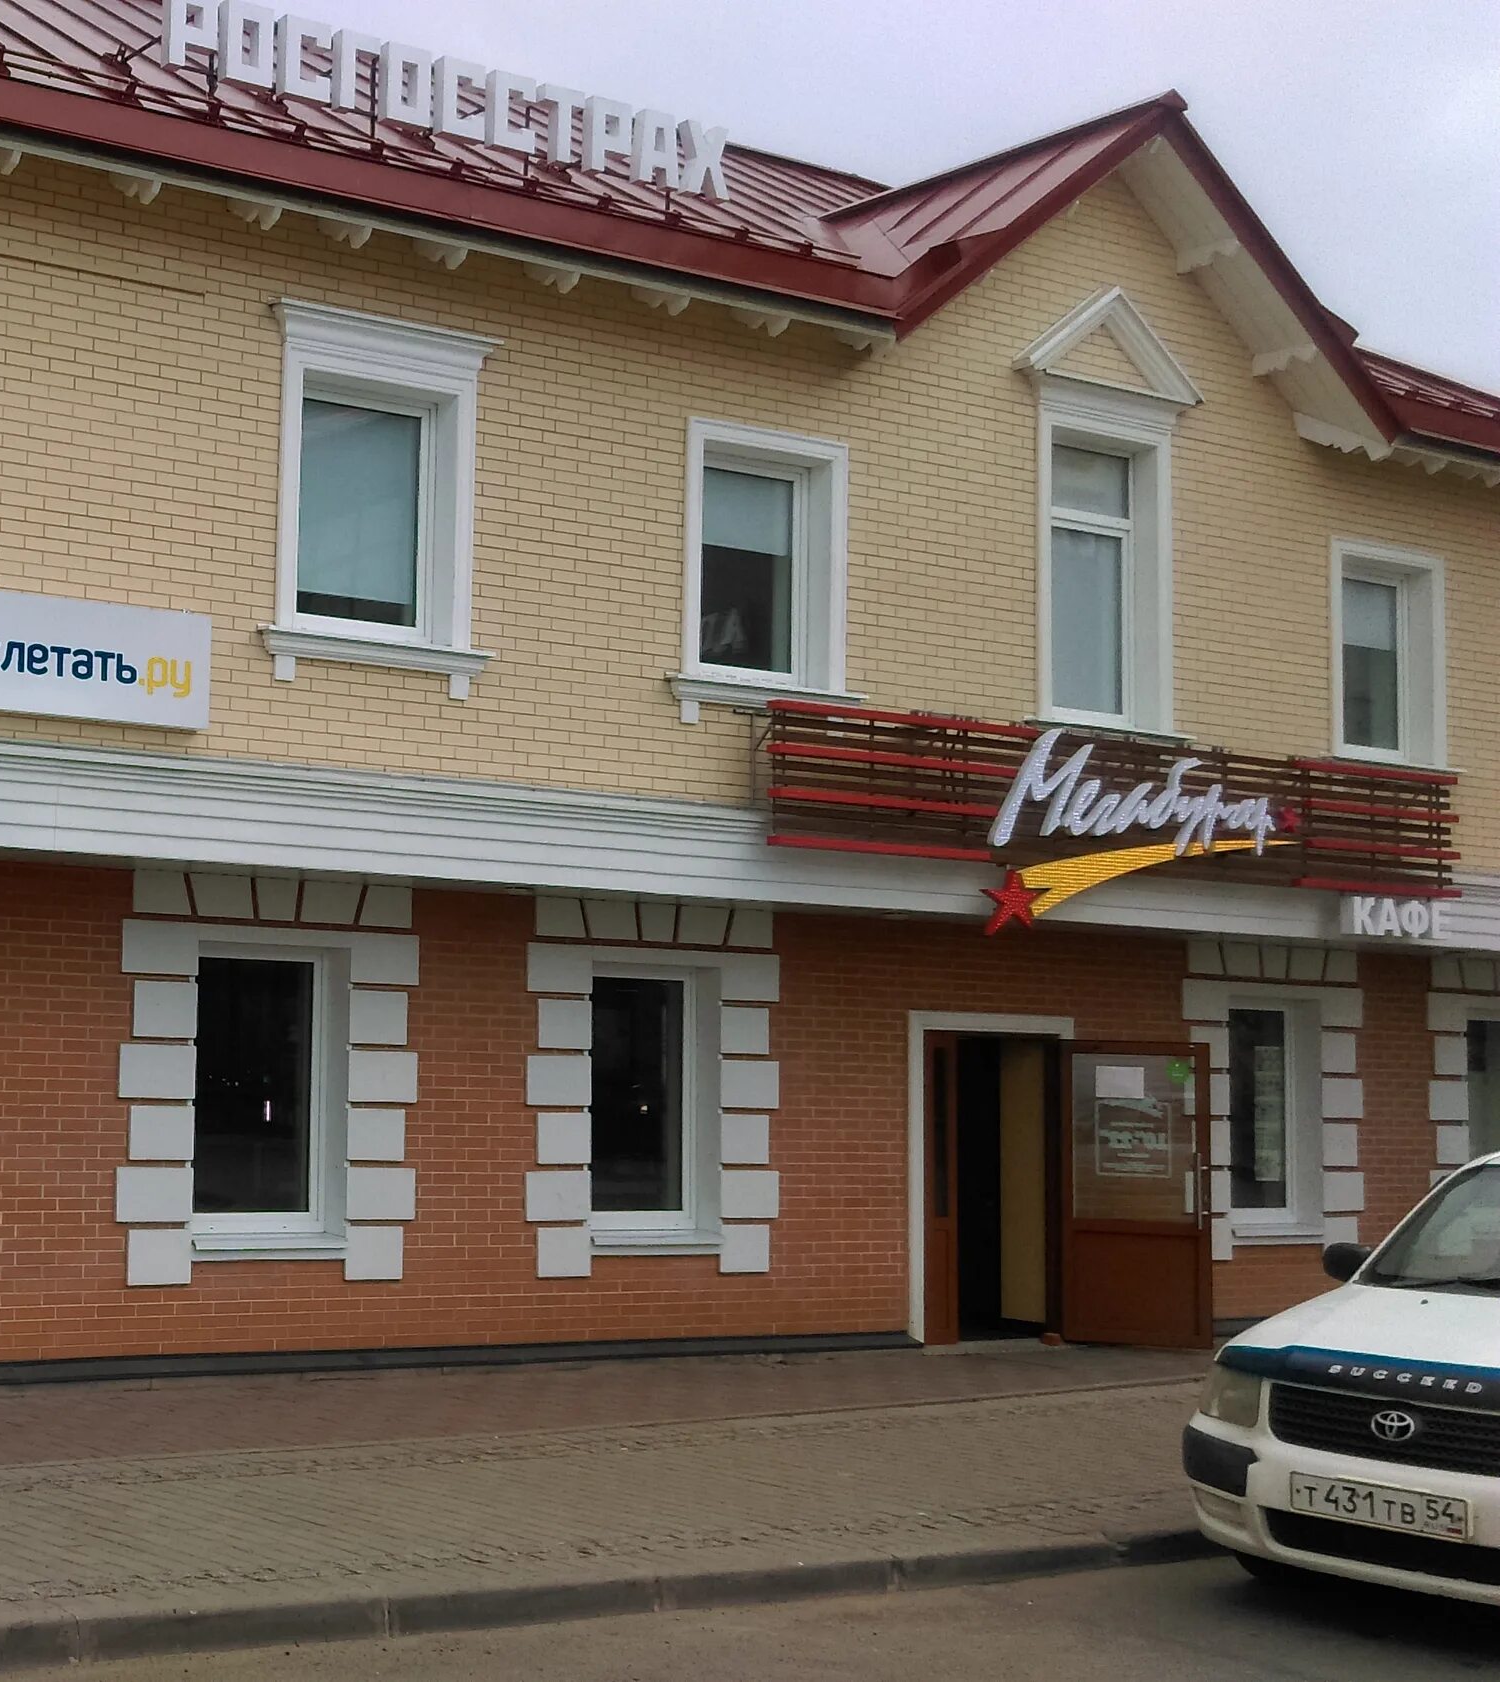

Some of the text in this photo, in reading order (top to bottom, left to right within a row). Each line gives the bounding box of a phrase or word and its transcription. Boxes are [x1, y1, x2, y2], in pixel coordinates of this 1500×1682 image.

[160, 0, 730, 204] РОСГОССТРАХ
[987, 727, 1277, 857] Мегабургер
[1351, 895, 1450, 941] КАФЕ
[1328, 1364, 1483, 1394] SUCCEED
[1425, 1498, 1456, 1524] 54
